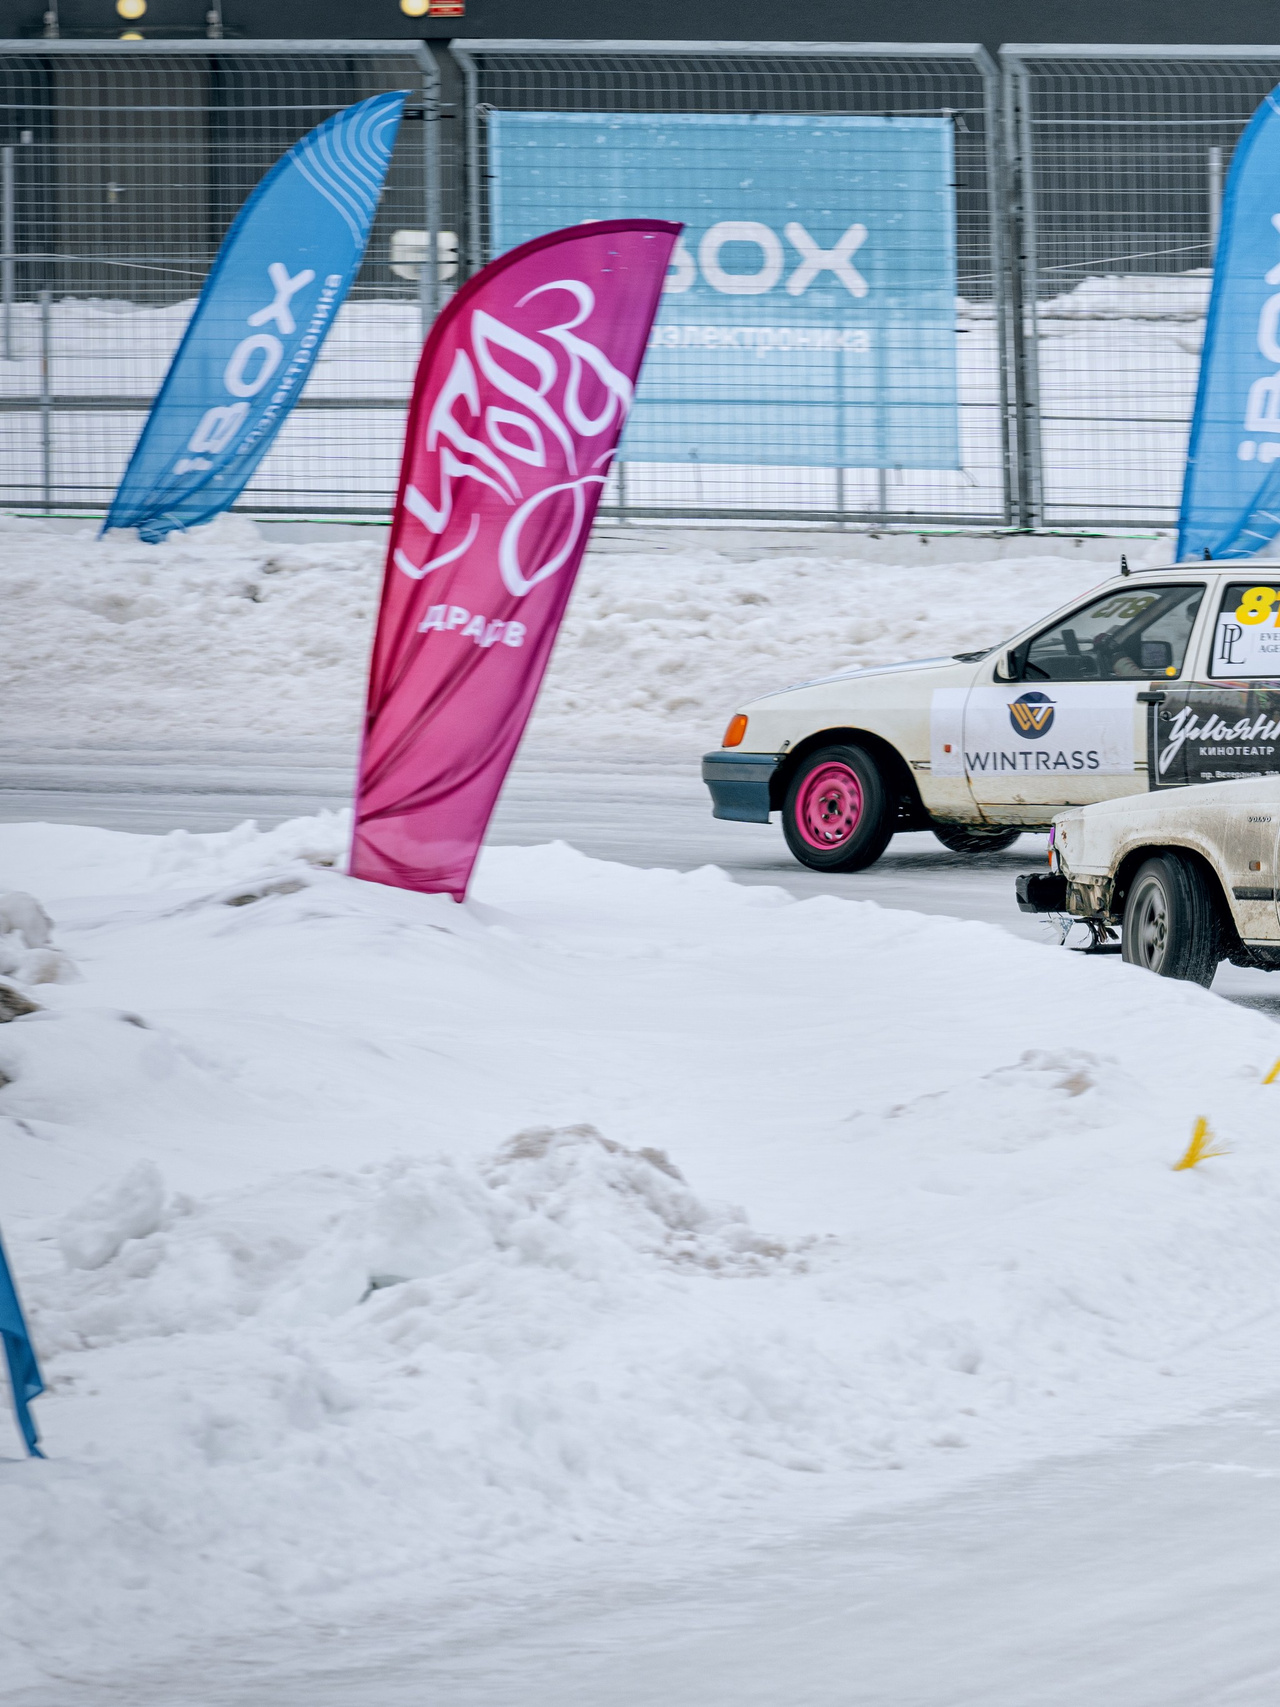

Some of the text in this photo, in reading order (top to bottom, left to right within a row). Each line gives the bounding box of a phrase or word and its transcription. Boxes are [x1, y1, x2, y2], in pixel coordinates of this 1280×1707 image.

[661, 221, 869, 298] OX
[965, 750, 1100, 771] WINTRASS
[1199, 746, 1275, 756] КИНОТЕАТР
